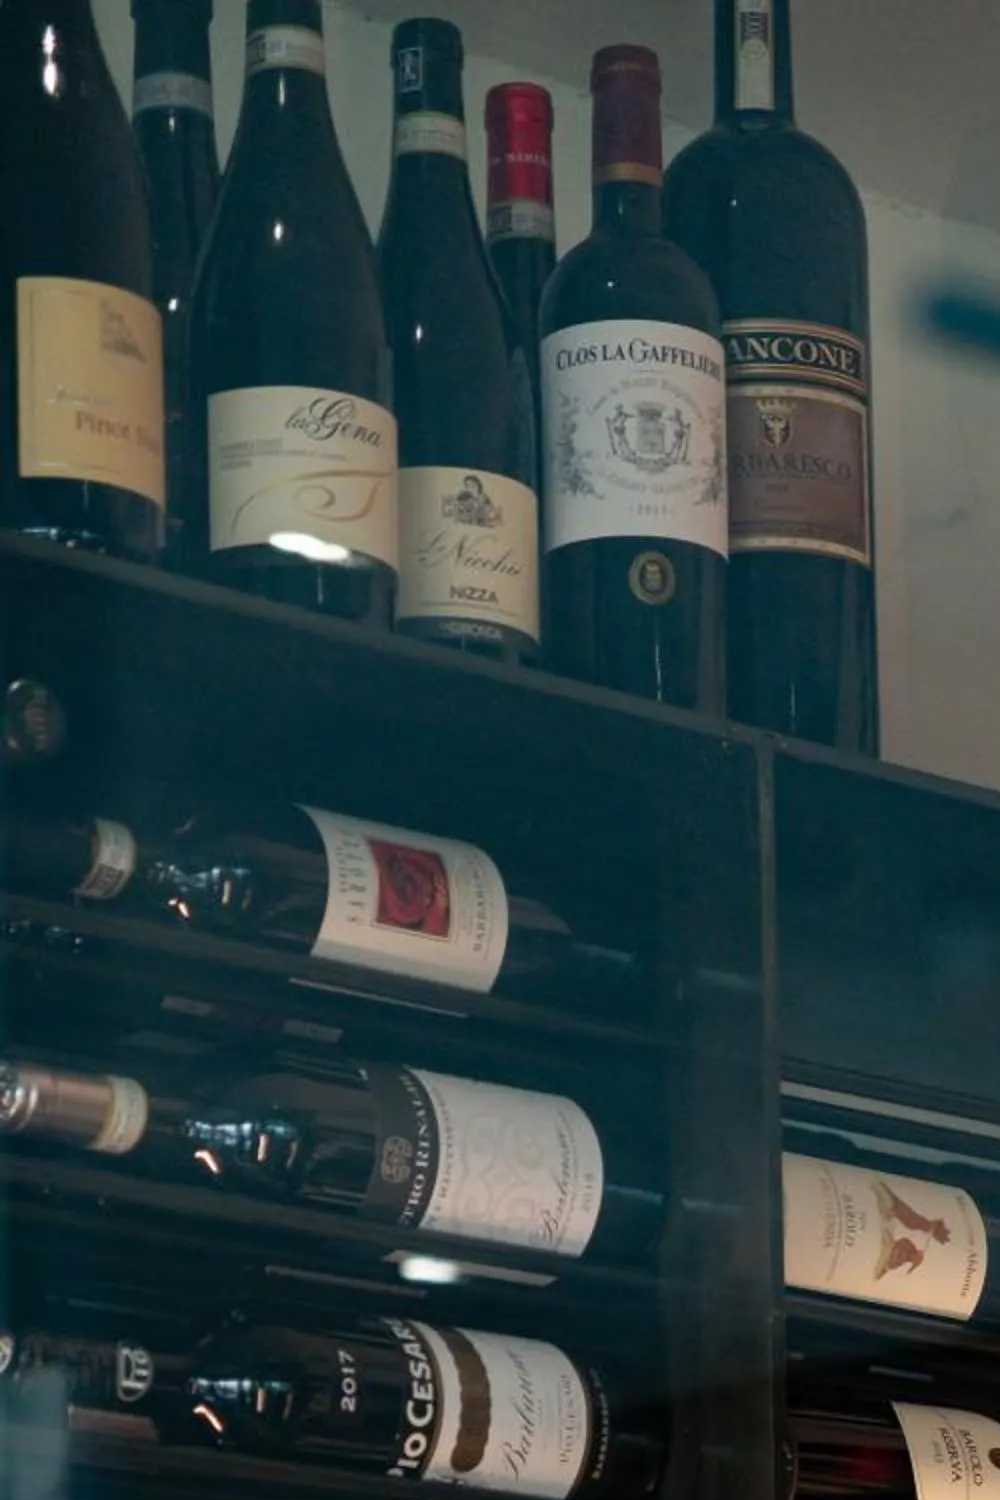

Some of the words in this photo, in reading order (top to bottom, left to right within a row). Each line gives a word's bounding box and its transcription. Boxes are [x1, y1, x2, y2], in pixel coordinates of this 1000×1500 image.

[556, 345, 597, 372] CLOS
[601, 344, 626, 364] LA
[449, 586, 499, 604] NIZZA
[338, 1349, 358, 1413] 2017
